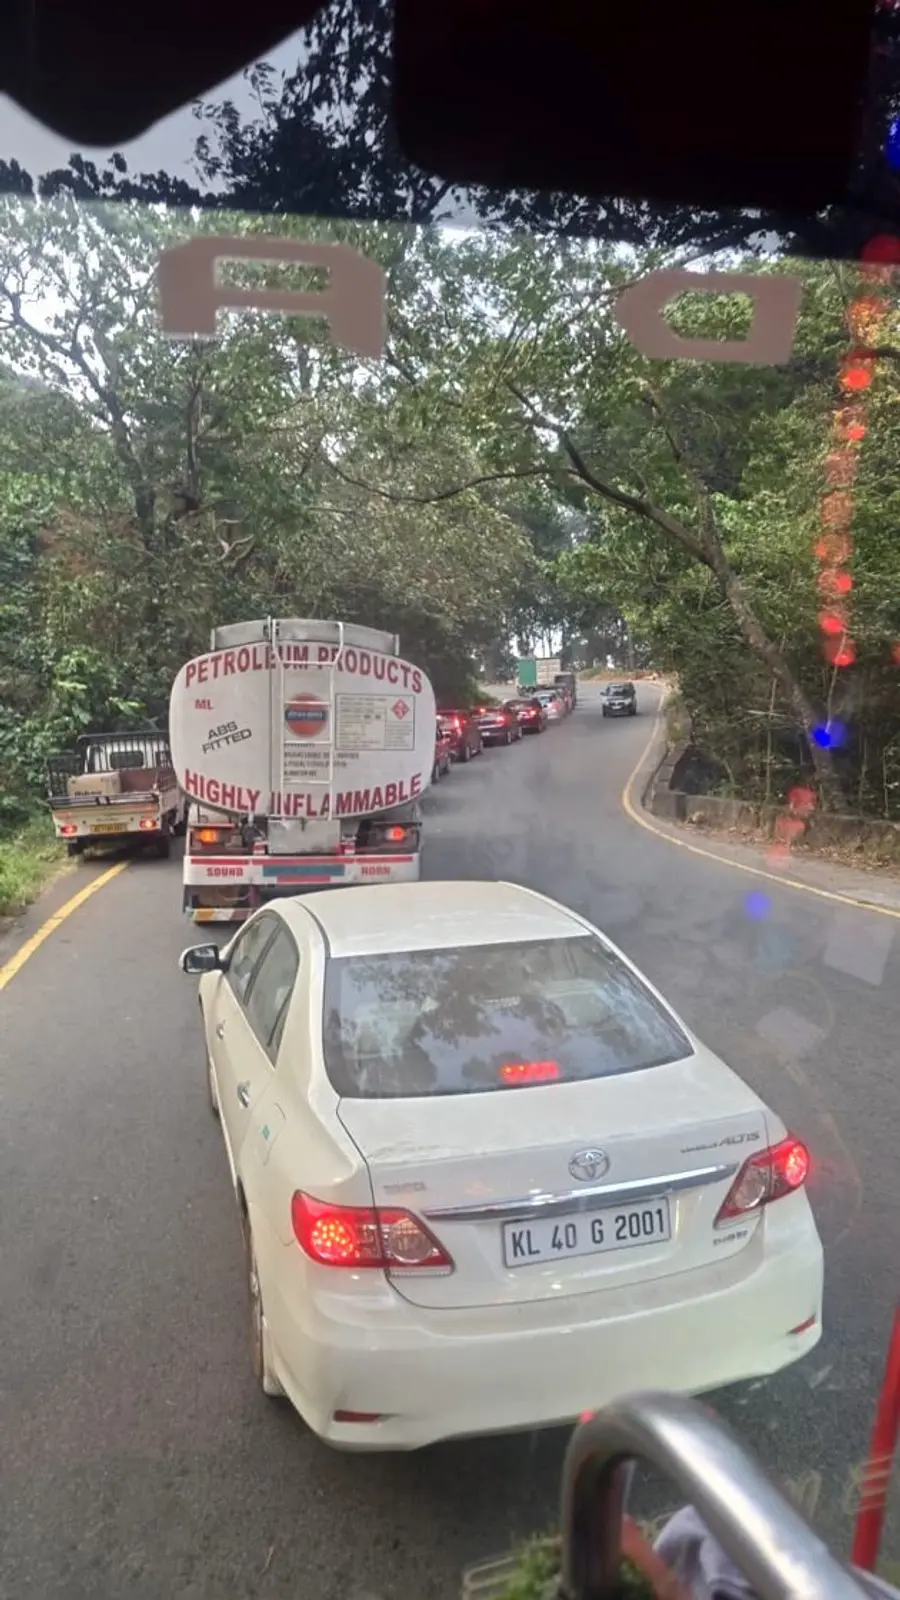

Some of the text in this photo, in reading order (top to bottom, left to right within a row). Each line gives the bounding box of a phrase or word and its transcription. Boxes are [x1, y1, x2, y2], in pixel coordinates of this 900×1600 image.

[185, 645, 422, 694] PETROLEUM PRODUCTS
[202, 728, 252, 754] FITTED
[208, 720, 238, 740] ABS
[185, 768, 260, 812] HIGHLY
[271, 772, 422, 816] INFLAMMABLE
[206, 867, 244, 877] SOUND
[361, 866, 391, 876] HORN
[511, 1208, 664, 1258] KL 40 G 2001
